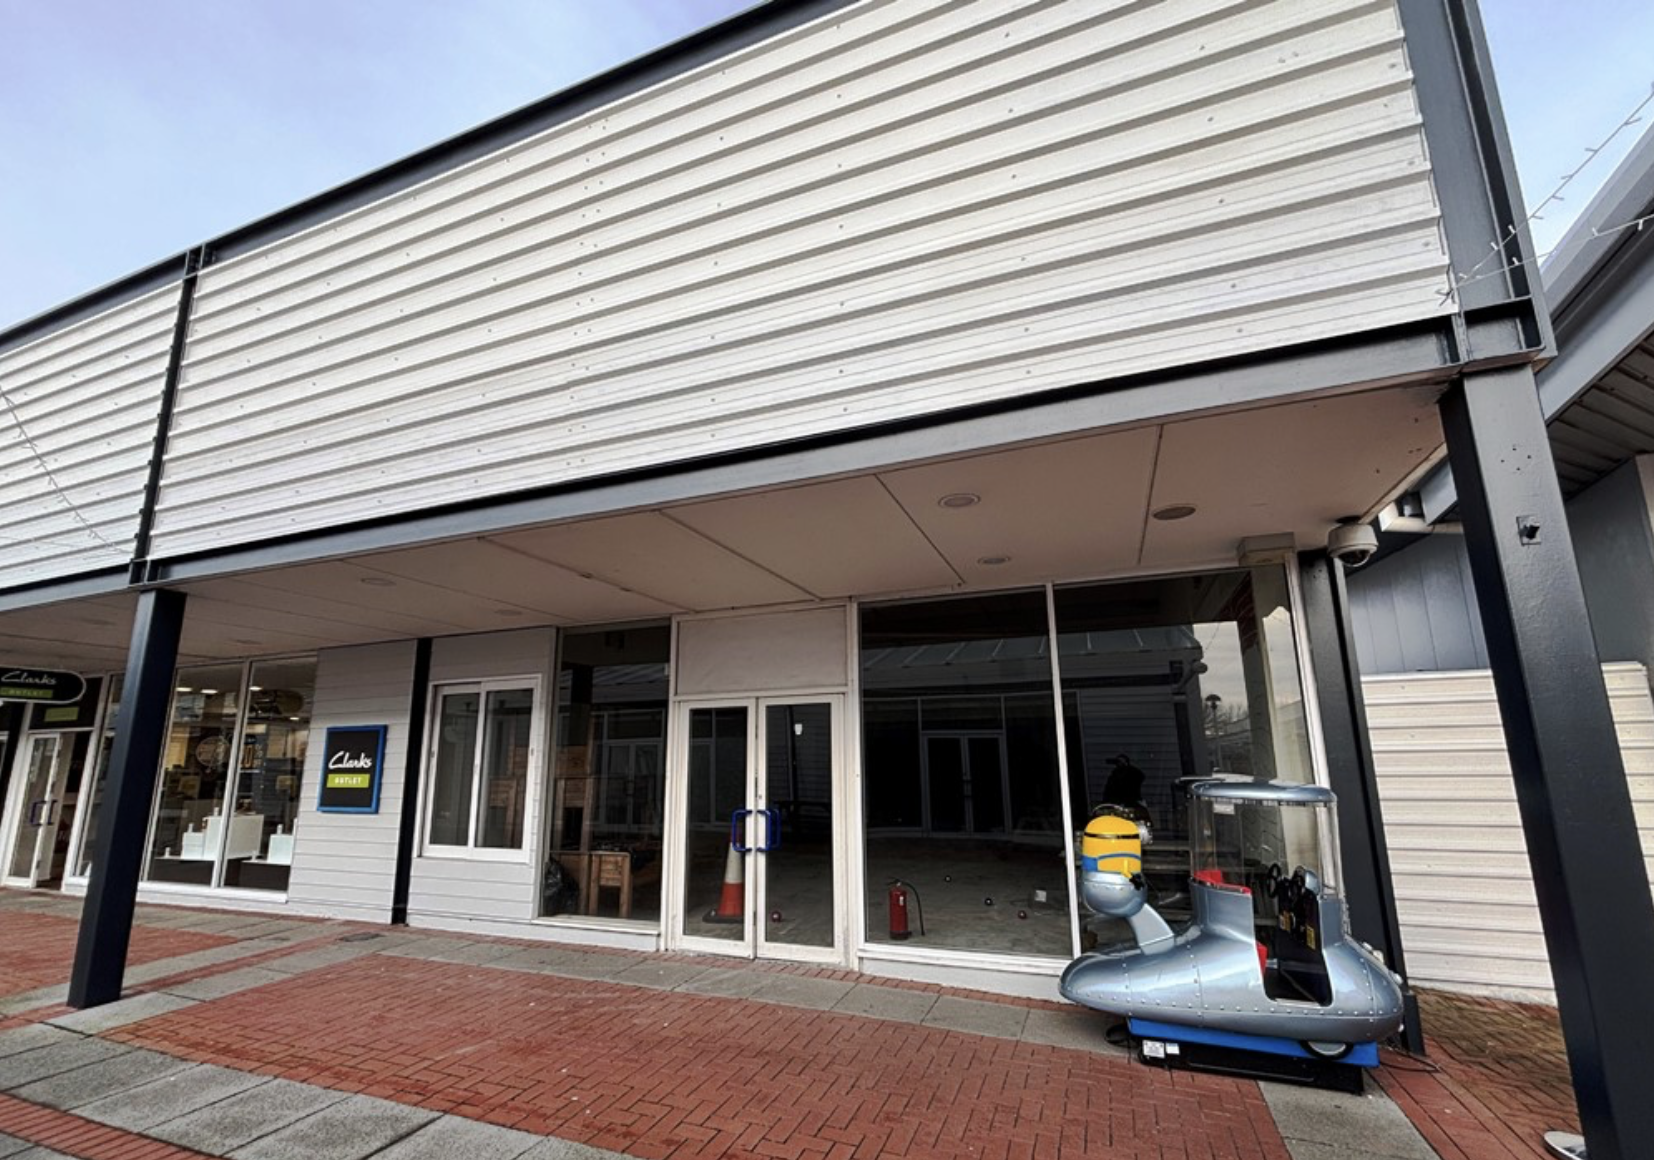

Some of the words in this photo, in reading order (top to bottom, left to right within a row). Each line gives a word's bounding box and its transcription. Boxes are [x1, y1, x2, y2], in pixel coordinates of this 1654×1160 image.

[1, 671, 57, 685] Clarks
[328, 751, 372, 769] Clarks
[334, 777, 362, 785] OUTLET
